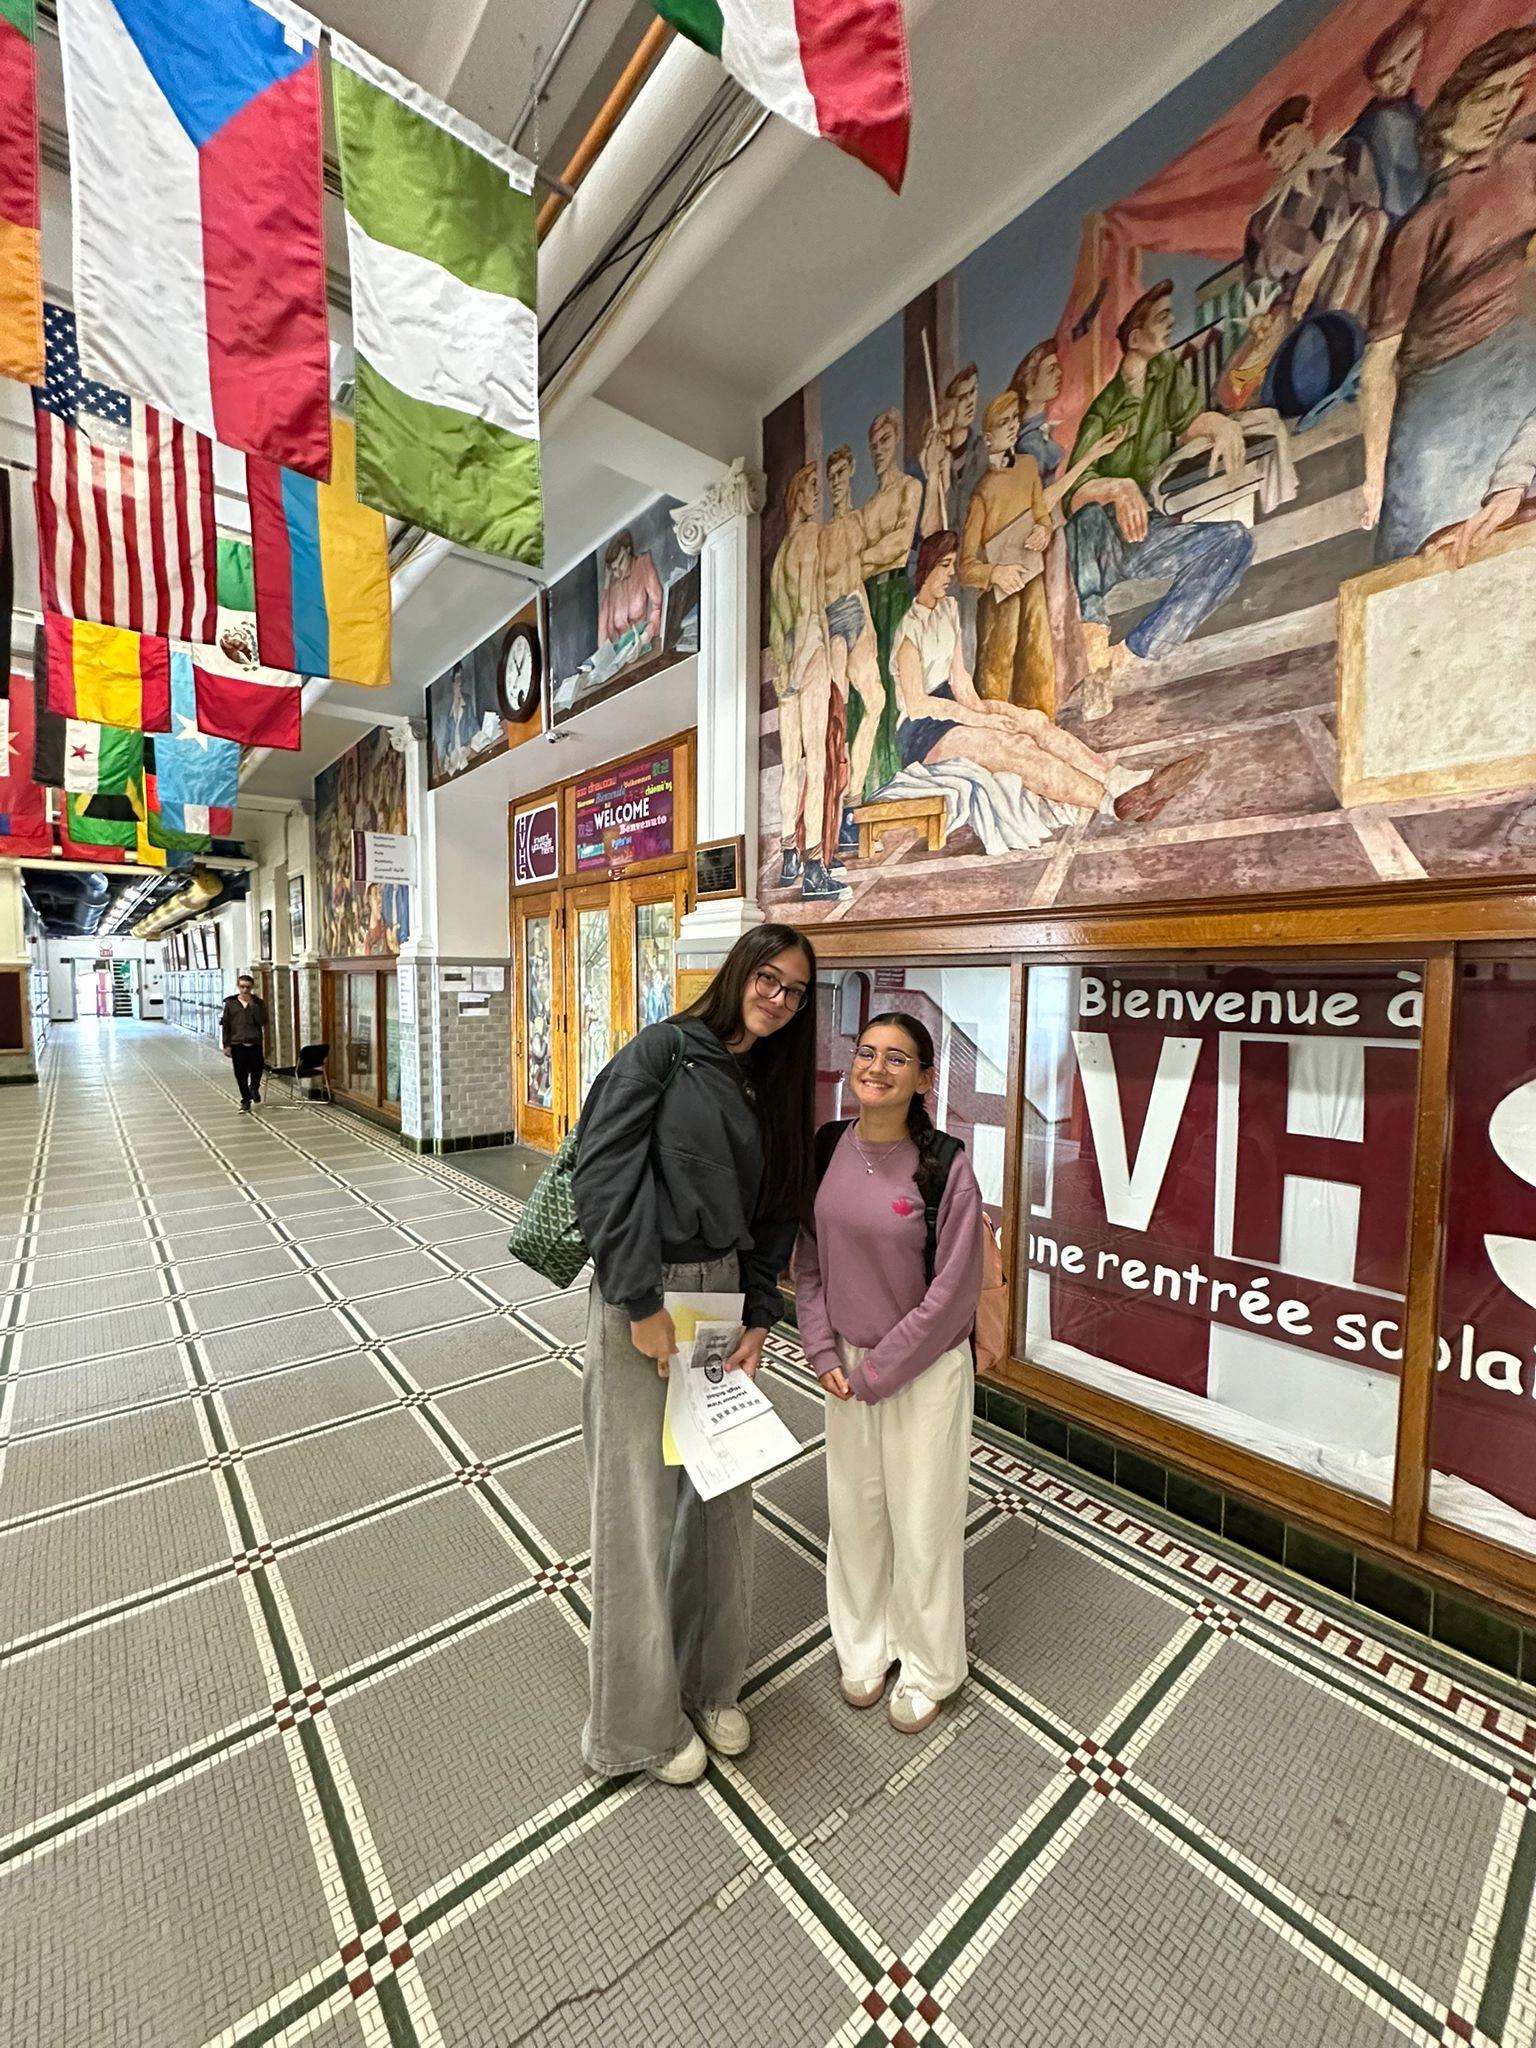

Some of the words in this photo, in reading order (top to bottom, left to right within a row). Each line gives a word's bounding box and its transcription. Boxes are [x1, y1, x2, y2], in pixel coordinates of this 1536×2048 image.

[594, 797, 650, 830] WELCOME
[619, 815, 667, 835] Benvenuto
[519, 816, 527, 880] HVHS
[1079, 977, 1360, 1027] Bienvenue
[1387, 971, 1421, 1027] à
[1097, 1252, 1313, 1335] rentrée
